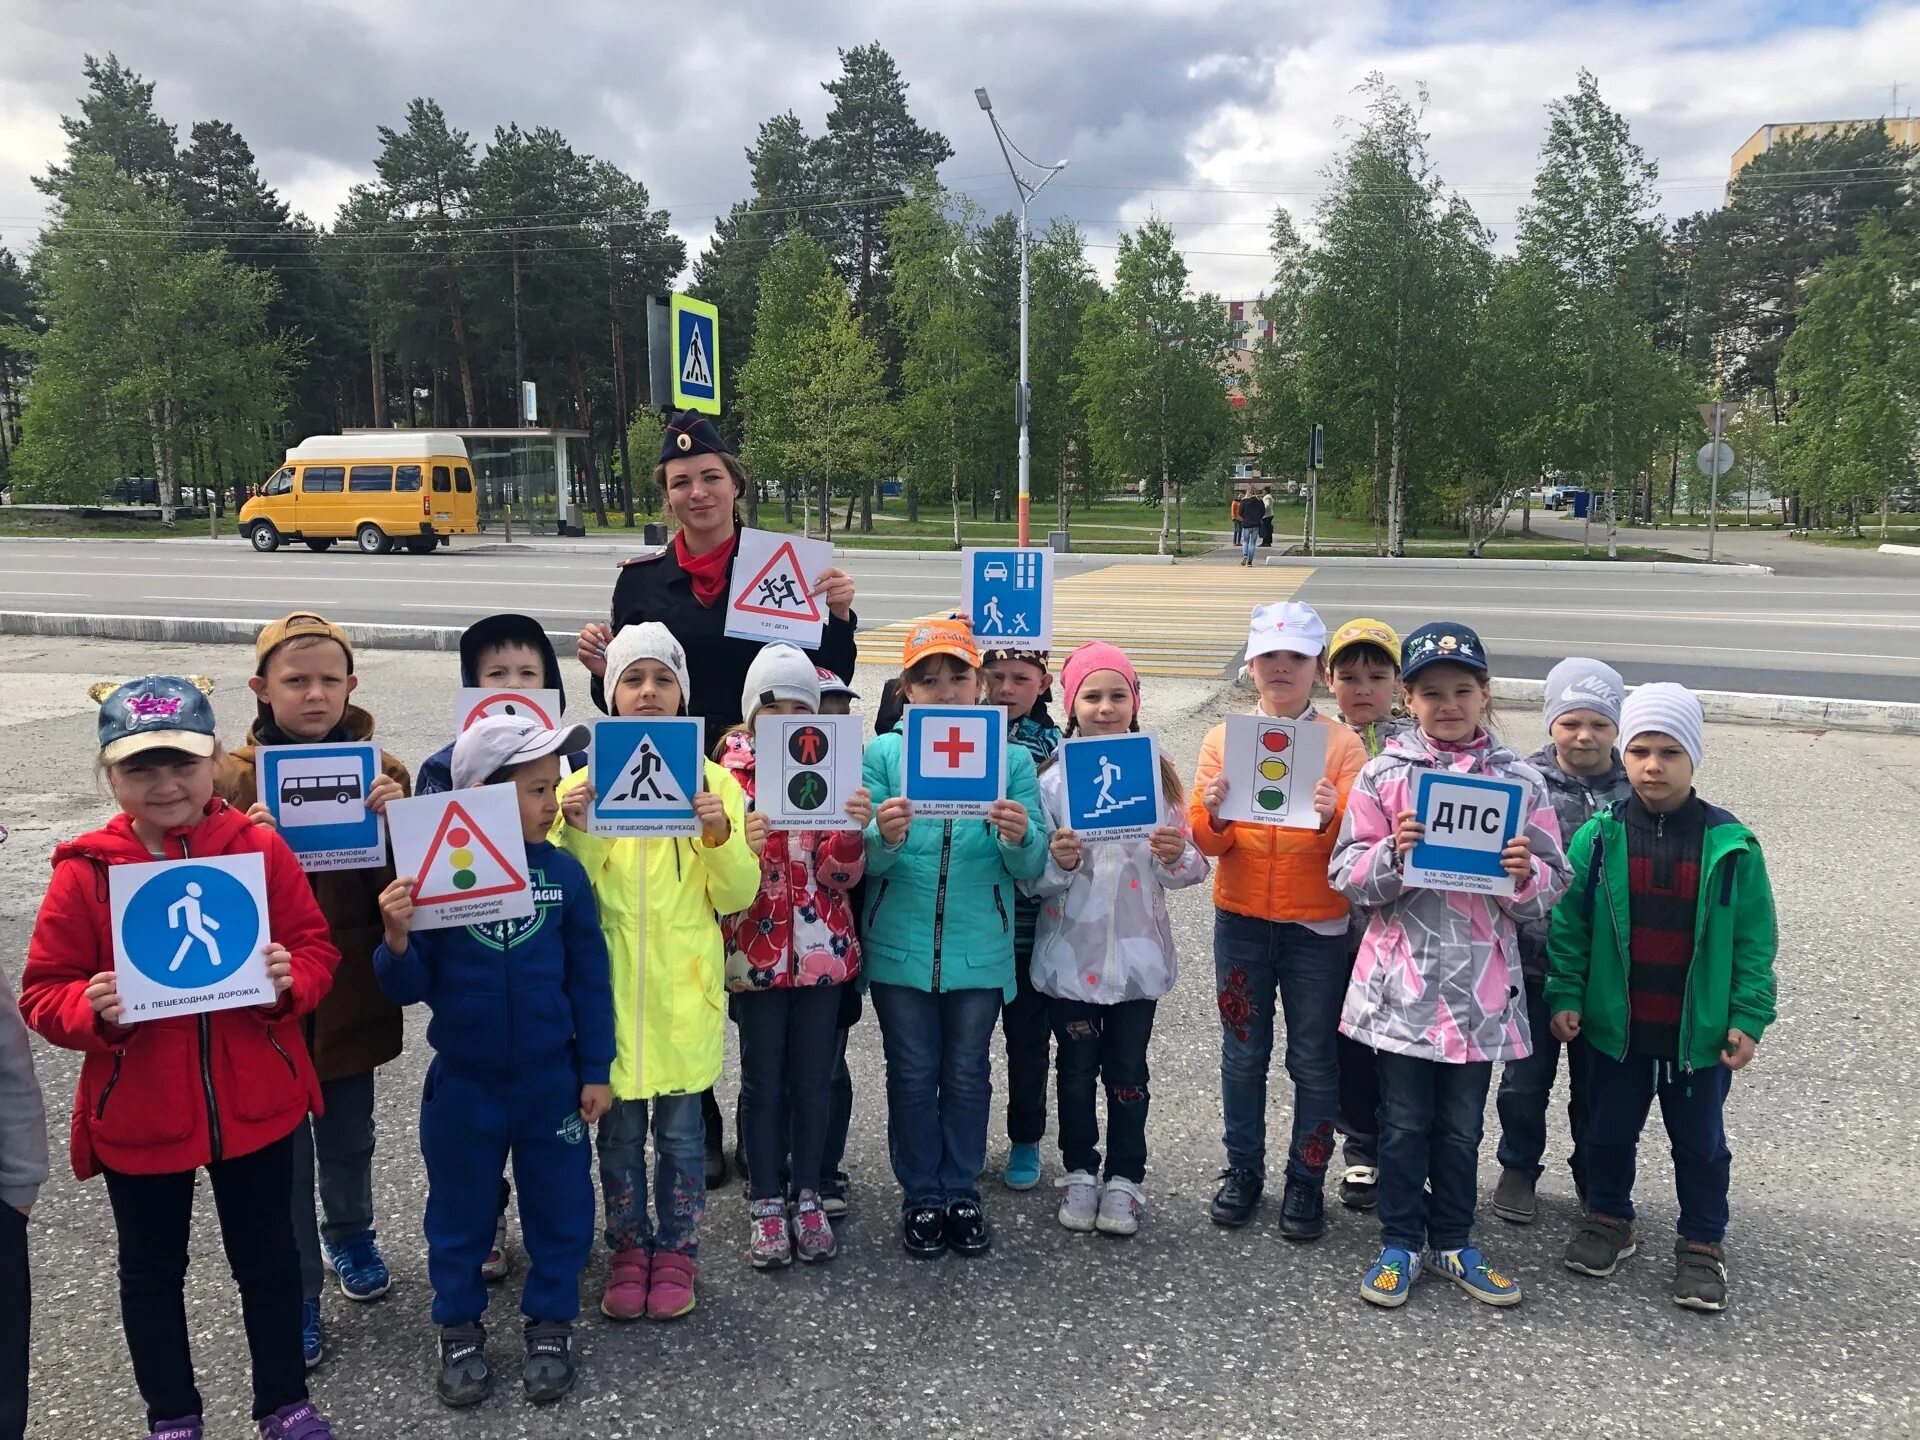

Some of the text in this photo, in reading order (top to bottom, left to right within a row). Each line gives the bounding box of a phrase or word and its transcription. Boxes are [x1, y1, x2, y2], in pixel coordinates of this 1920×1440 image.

[1575, 675, 1621, 708] NIKE
[1253, 815, 1285, 823] СВЕТОФОР
[1432, 801, 1501, 835] ДПС
[616, 823, 663, 831] ПЕШЕХОДНЫЙ
[1105, 826, 1142, 834] ПОДЗЕМНЫЙ
[1122, 832, 1150, 840] ПЕРЕХОД
[326, 849, 367, 858] ОСТАНОВКИ
[333, 856, 380, 865] ТРОЛЛЕЙБУСА
[1423, 877, 1464, 887] ПАТРУЛЬНОЙ
[1458, 874, 1494, 882] ДОРОЖНО-
[449, 900, 504, 913] СВЕТОФОРНОЕ
[441, 910, 500, 922] РЕГУЛИРОВАНИЕ
[133, 987, 260, 1011] 4.6 ПЕШЕХОДНАЯ ДОРОЖКА
[282, 1407, 311, 1429] SPORT
[158, 1430, 193, 1440] SPORT
